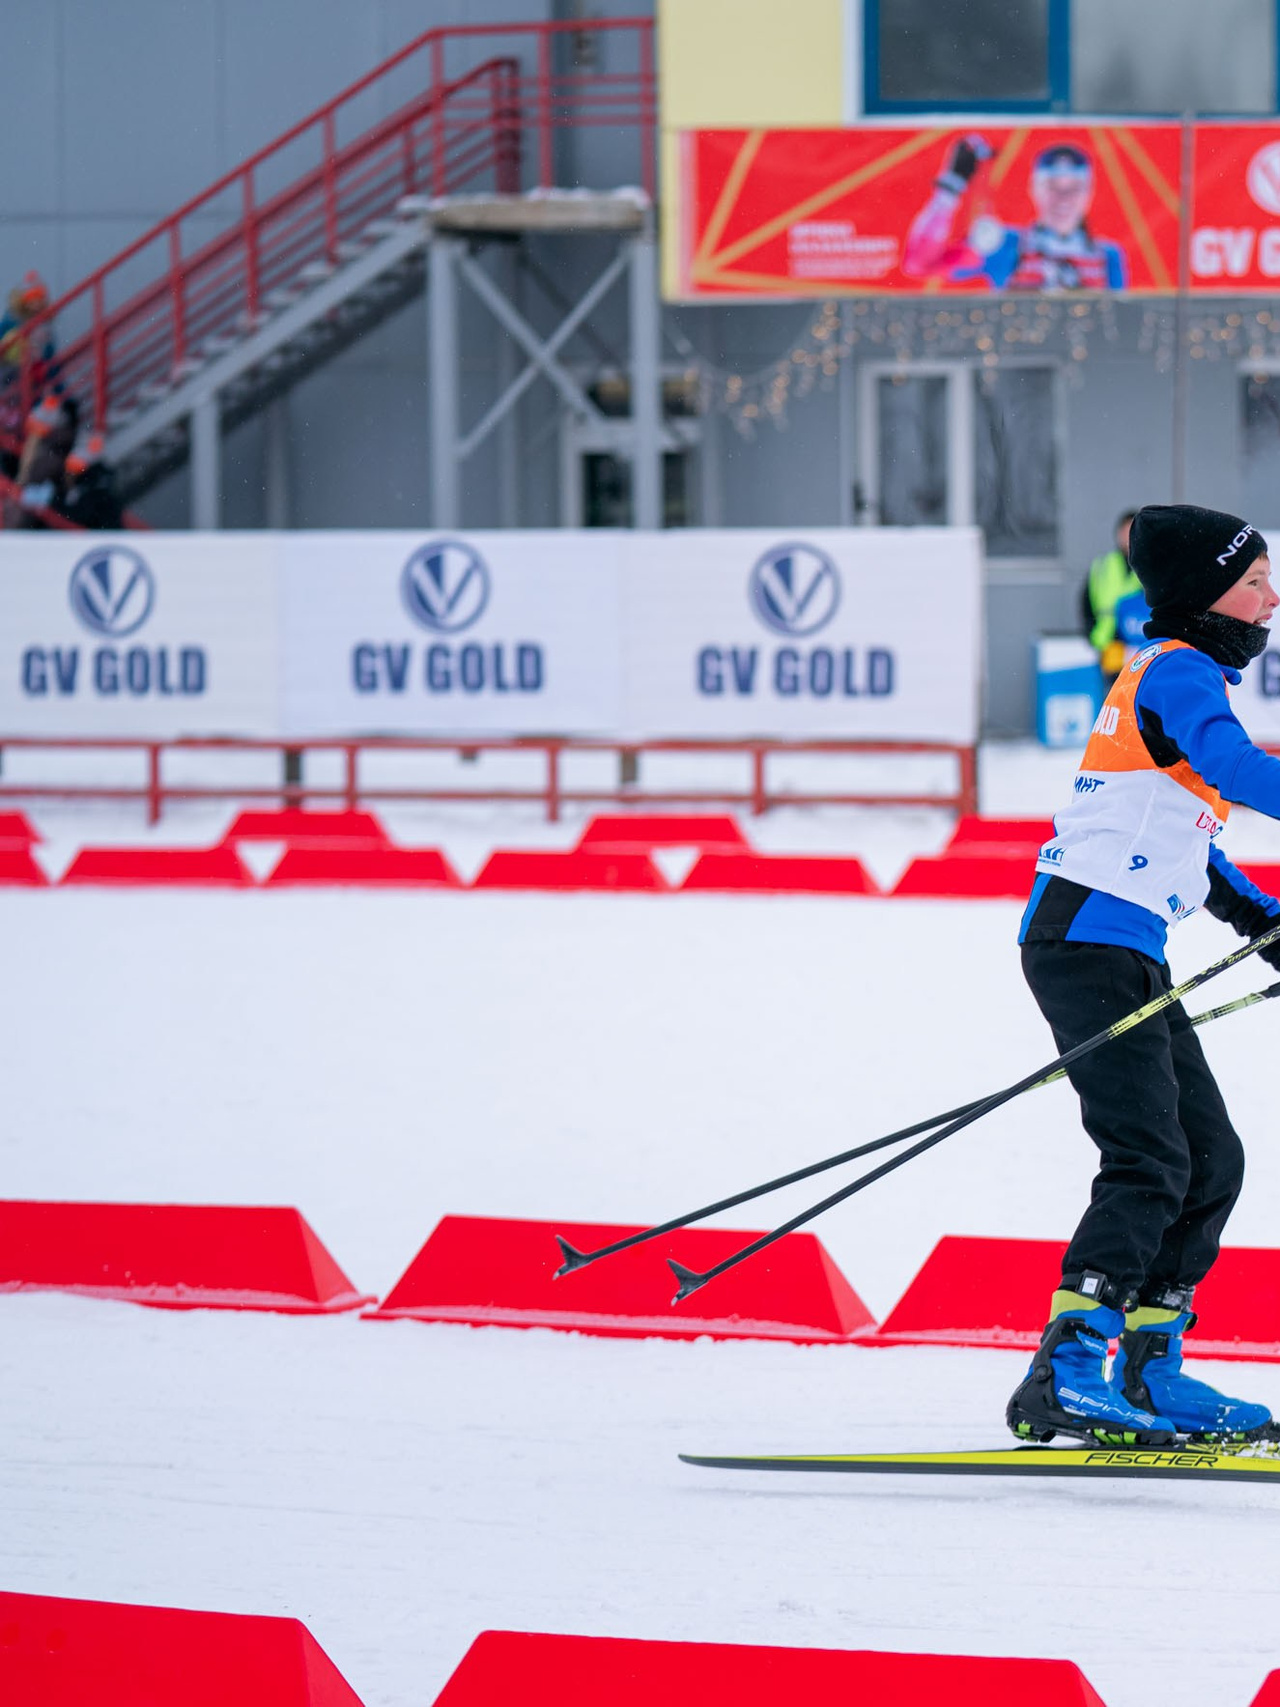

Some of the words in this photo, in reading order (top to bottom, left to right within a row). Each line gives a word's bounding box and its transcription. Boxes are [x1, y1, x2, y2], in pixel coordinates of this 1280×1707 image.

[1192, 226, 1255, 278] GV
[21, 645, 80, 696] GV
[93, 645, 207, 697] GOLD
[352, 642, 411, 692] GV
[426, 642, 544, 693] GOLD
[696, 646, 758, 697] GV
[774, 646, 896, 698] GOLD
[1128, 854, 1148, 871] 9
[1058, 1387, 1155, 1427] SPINE
[1084, 1452, 1218, 1468] FISCHER
